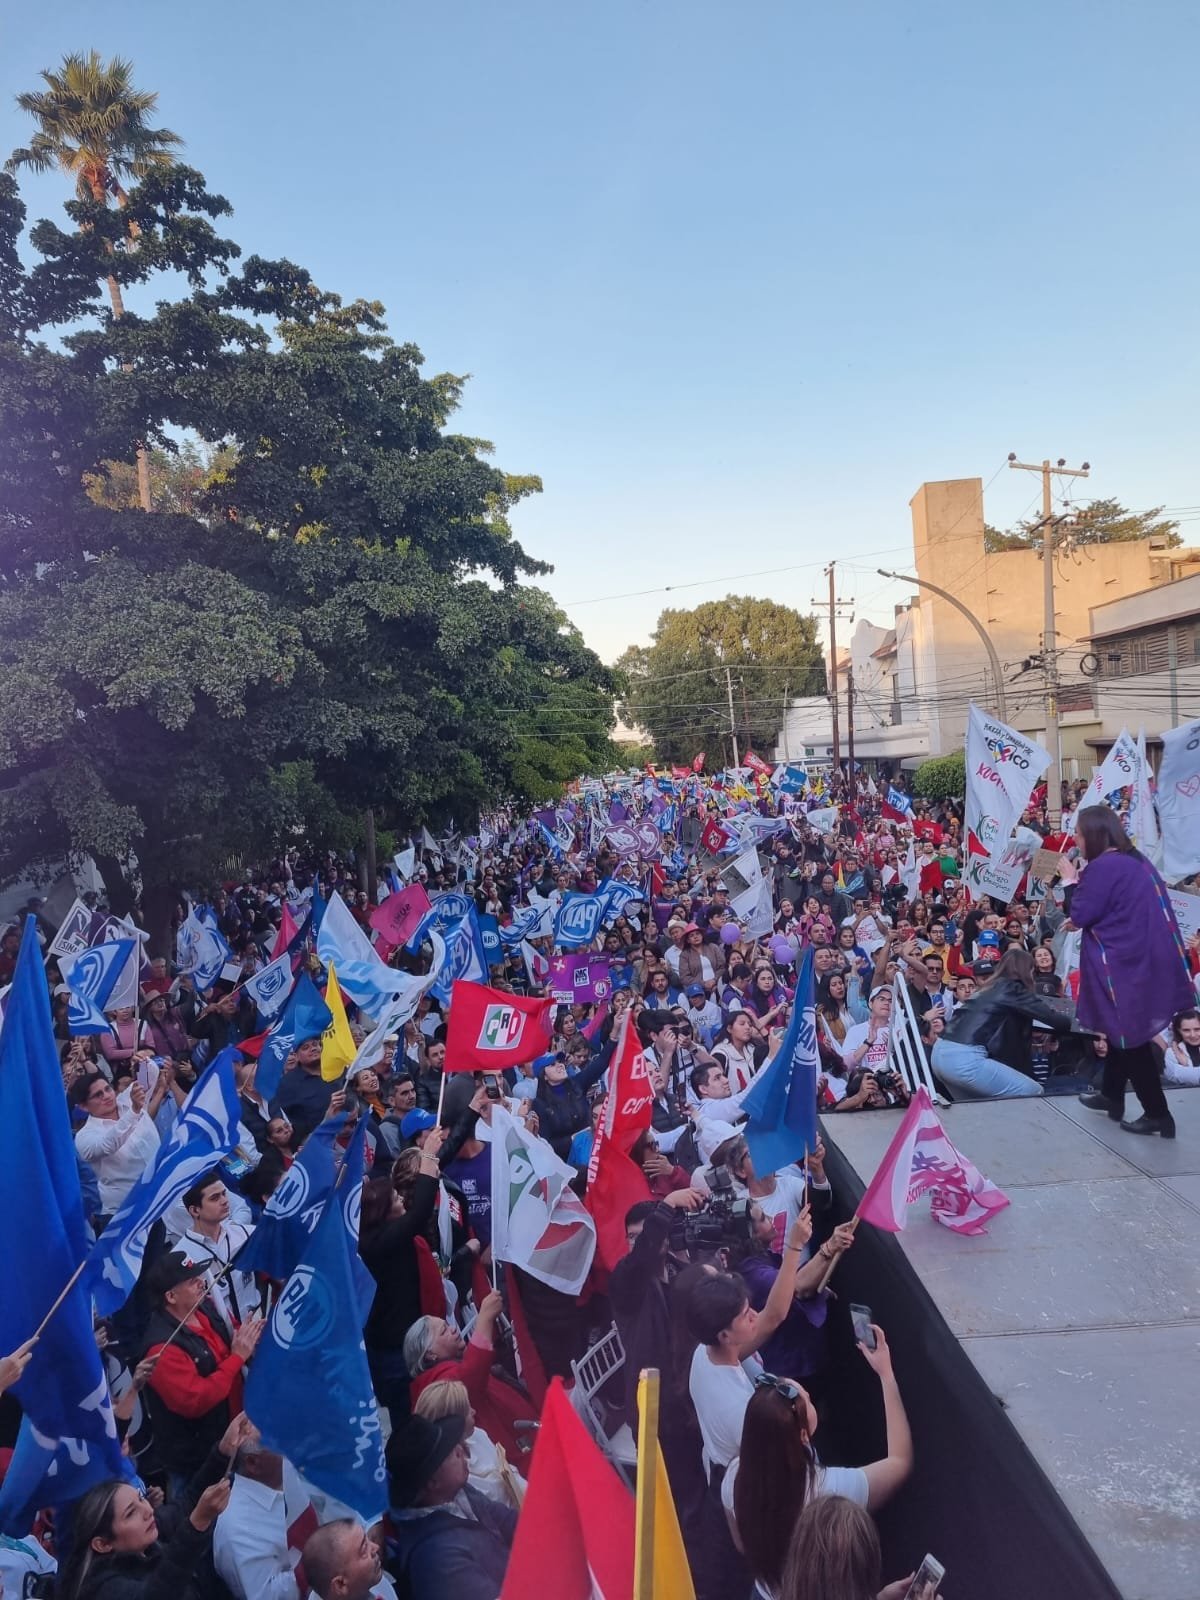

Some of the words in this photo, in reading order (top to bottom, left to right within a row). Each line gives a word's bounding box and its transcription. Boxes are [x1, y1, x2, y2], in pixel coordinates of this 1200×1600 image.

[984, 736, 1030, 770] ÉXICO
[487, 1013, 519, 1035] PRI
[273, 1176, 300, 1209] AN
